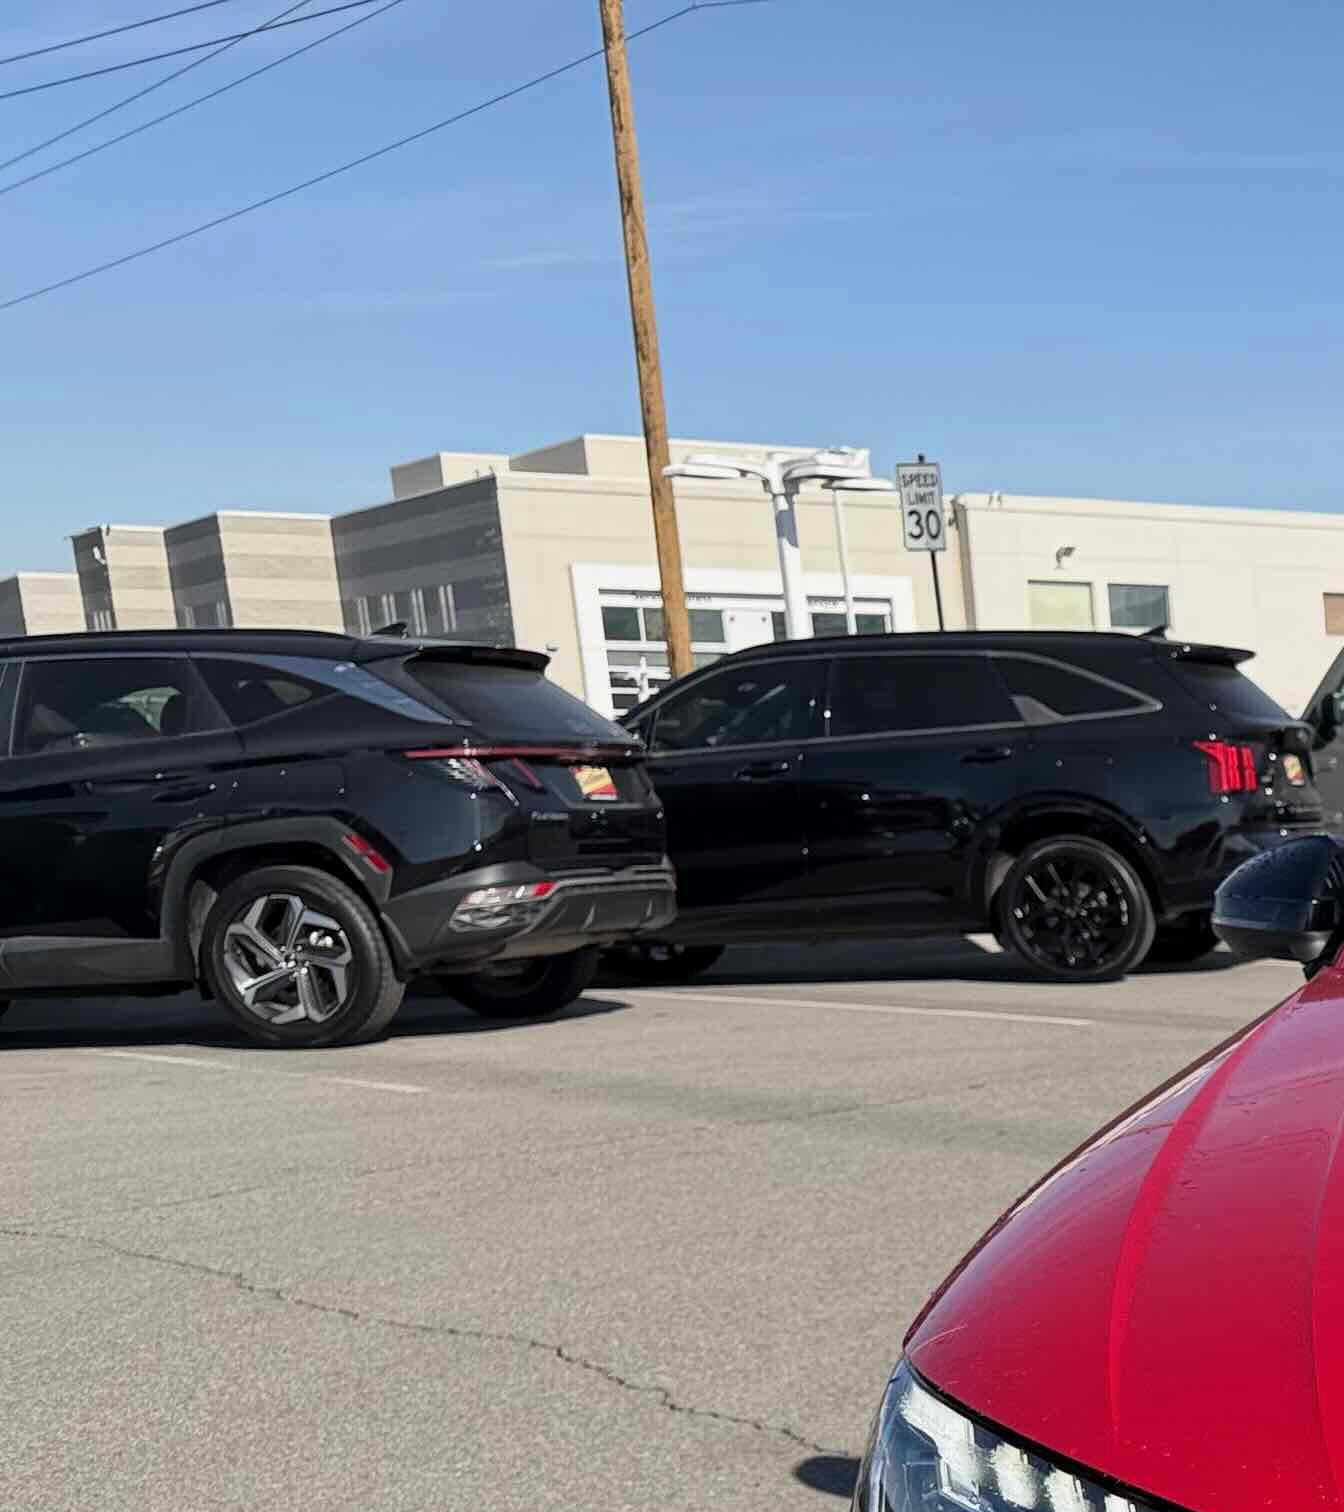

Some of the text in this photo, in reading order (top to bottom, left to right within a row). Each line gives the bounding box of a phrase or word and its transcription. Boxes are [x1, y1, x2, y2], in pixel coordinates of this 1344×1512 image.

[902, 472, 938, 487] SPEED
[905, 490, 935, 505] LIMIT
[907, 509, 941, 539] 30
